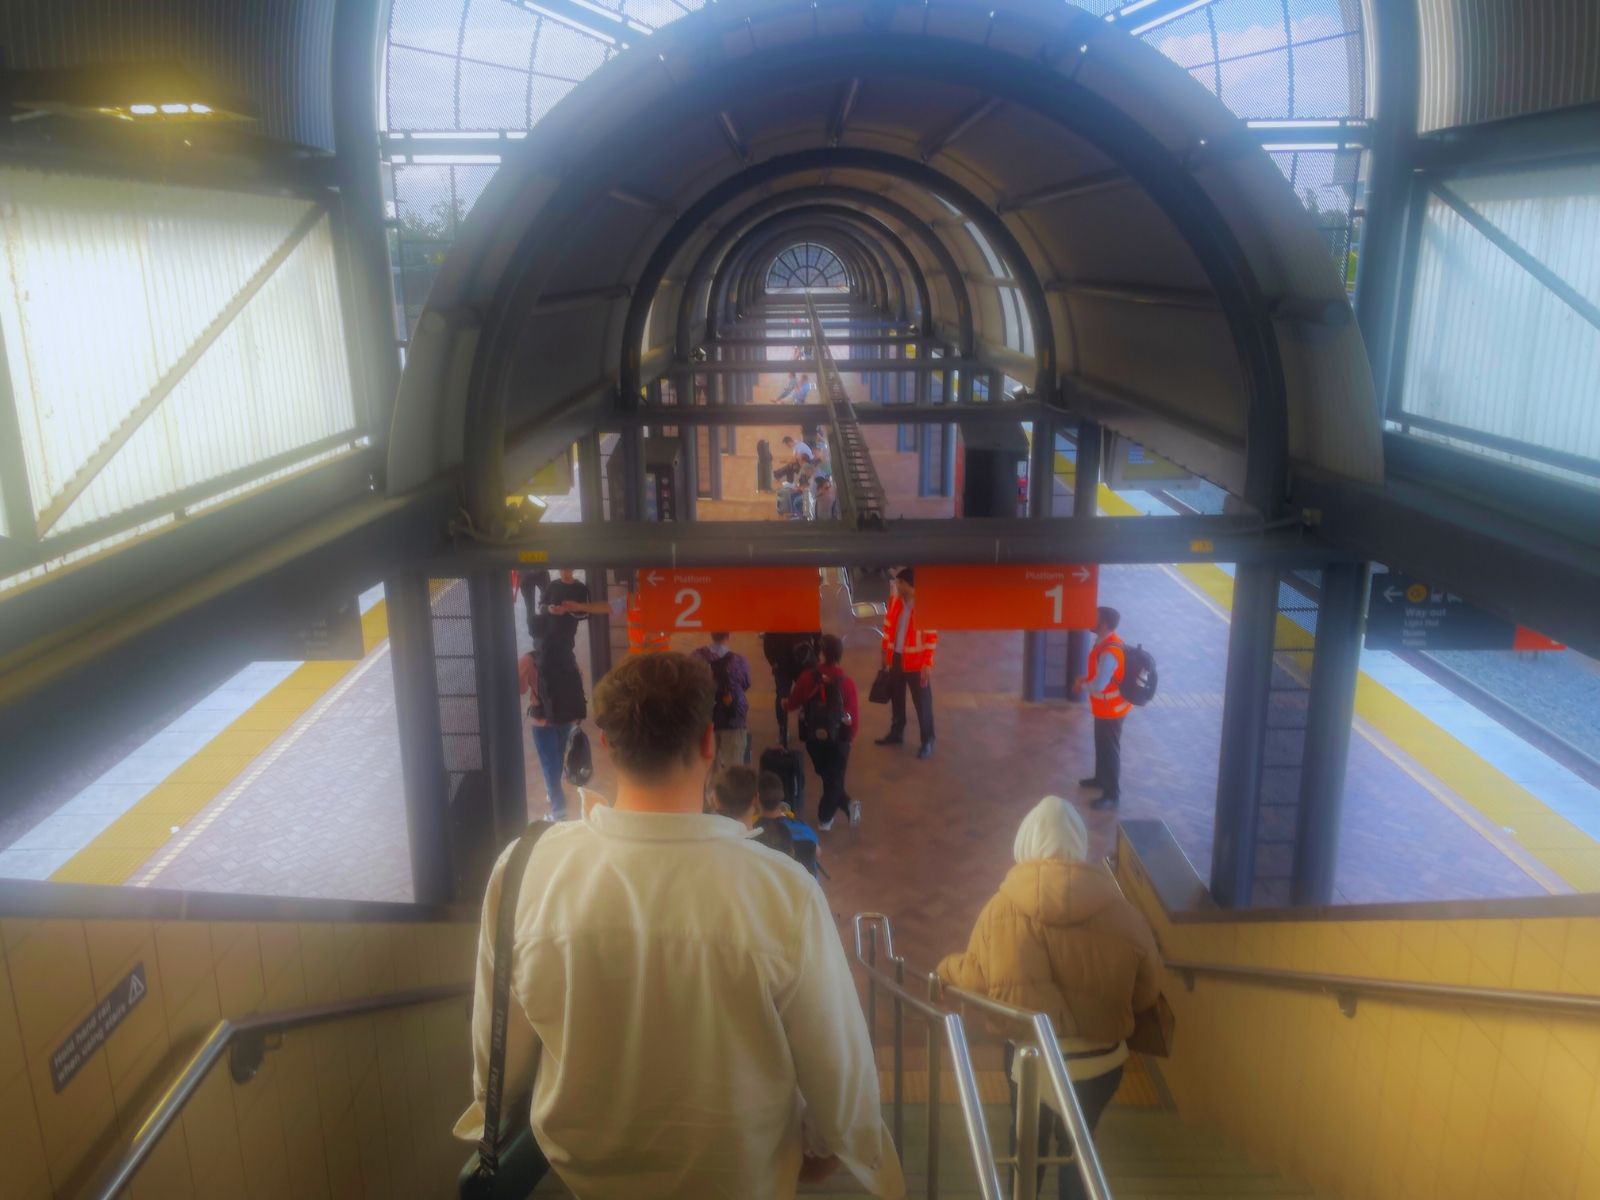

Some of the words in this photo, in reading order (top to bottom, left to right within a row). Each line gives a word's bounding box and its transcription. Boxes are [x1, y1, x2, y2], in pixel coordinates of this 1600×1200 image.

[673, 574, 711, 584] Platform
[1025, 570, 1064, 579] Platform
[674, 588, 702, 627] 2
[1045, 585, 1063, 624] 1
[1405, 608, 1426, 618] Way
[1430, 608, 1446, 617] out
[57, 1053, 80, 1083] when
